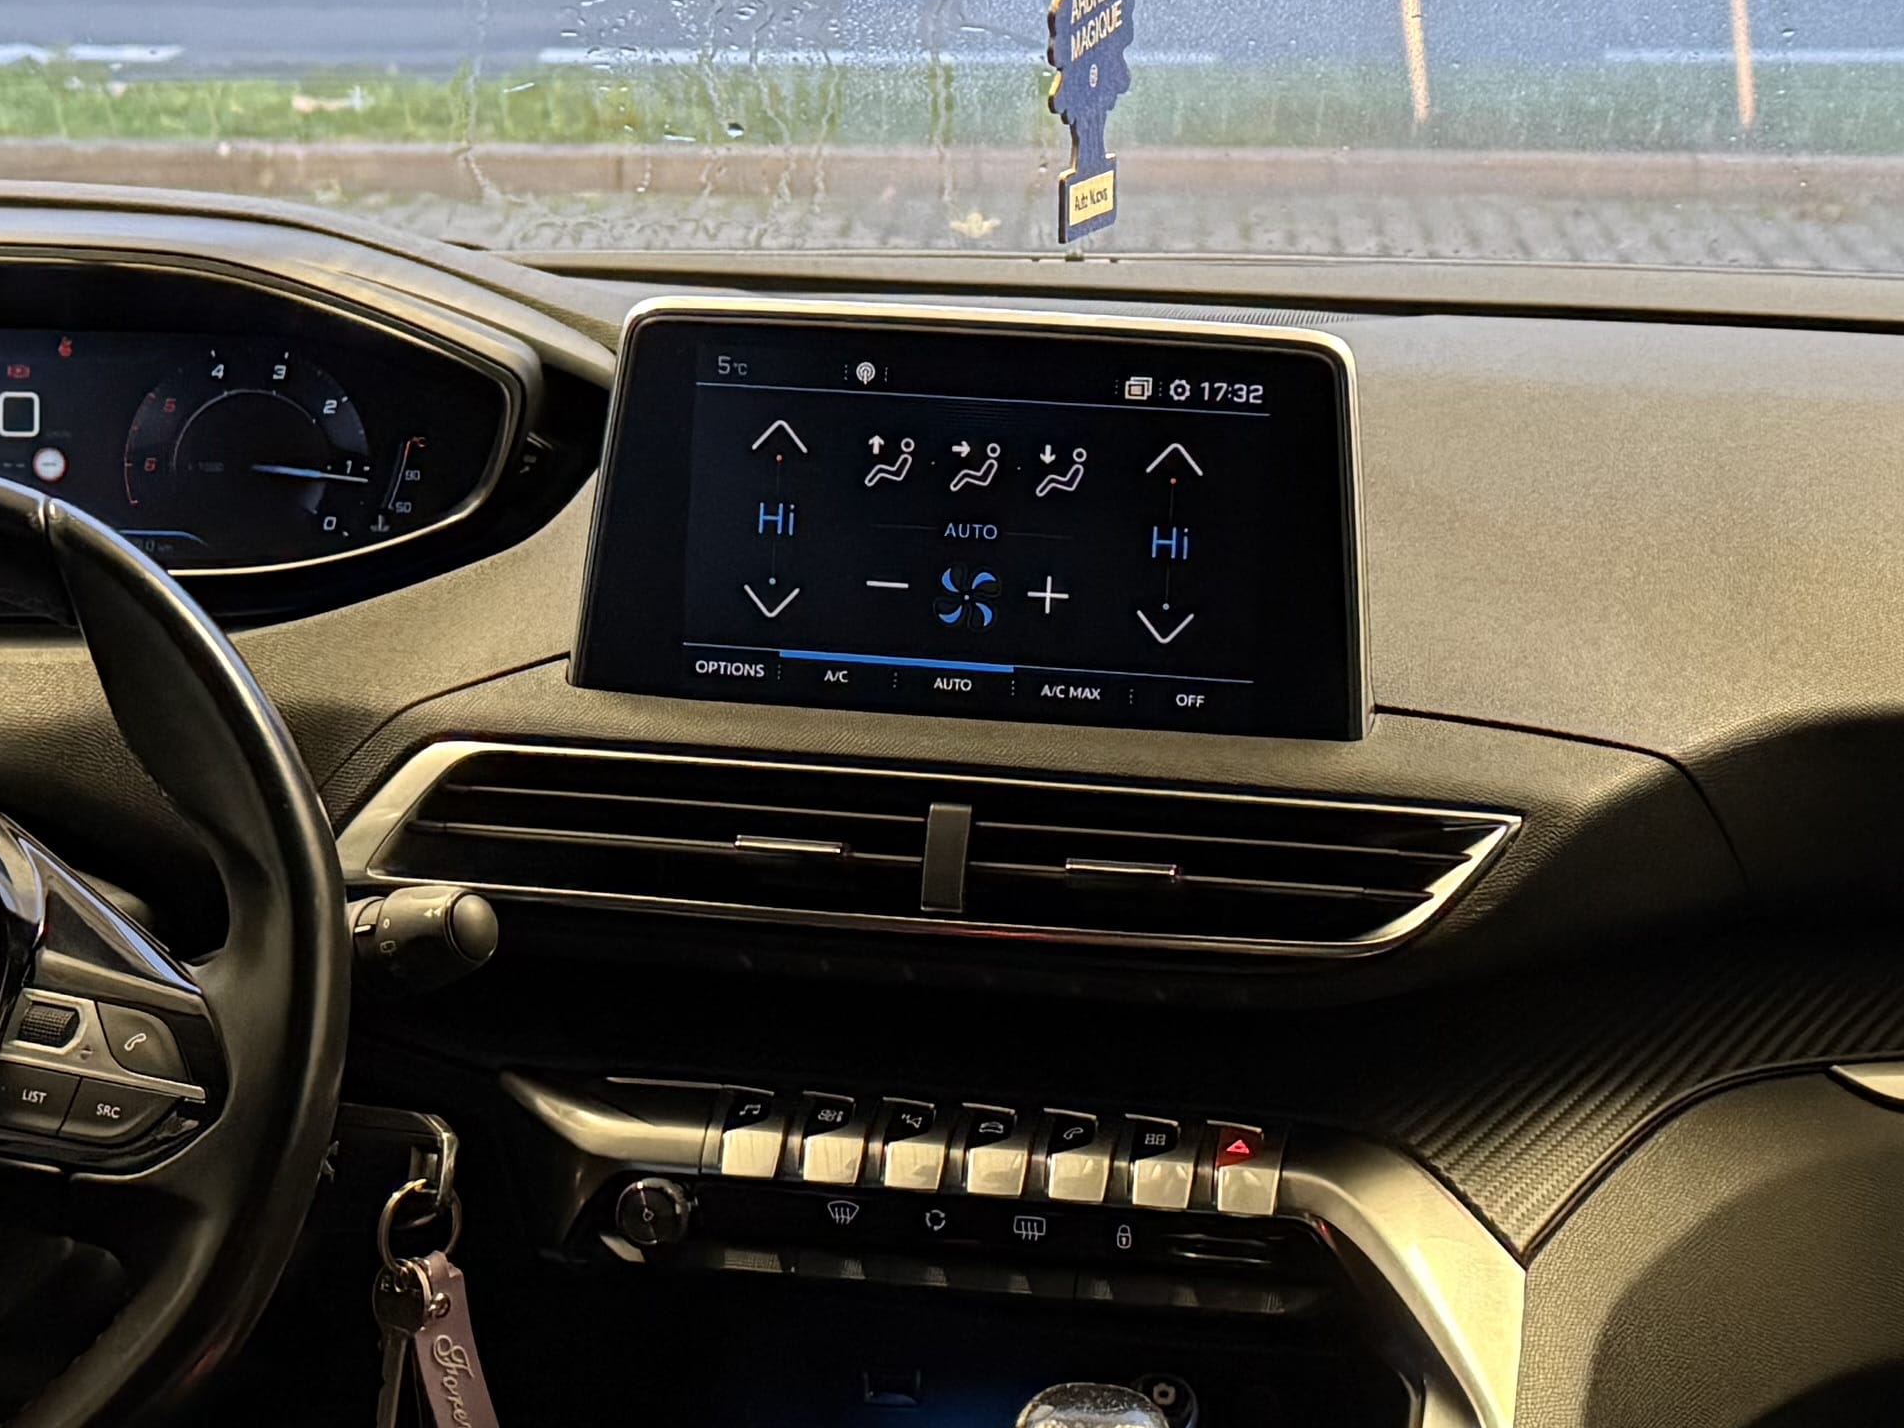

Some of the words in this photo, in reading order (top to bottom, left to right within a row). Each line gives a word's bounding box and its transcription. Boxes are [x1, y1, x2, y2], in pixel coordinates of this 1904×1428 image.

[1070, 0, 1123, 62] MAGIQUE
[210, 363, 225, 380] 4
[272, 364, 287, 380] 3
[1199, 381, 1264, 404] 17:32
[163, 398, 177, 413] 5
[322, 399, 338, 414] 2
[143, 457, 158, 472] 6
[322, 515, 338, 531] 0
[757, 501, 796, 535] Hi
[943, 522, 998, 540] AUTO
[1150, 525, 1190, 560] Hi
[695, 659, 765, 678] OPTIONS
[823, 669, 849, 683] A/C
[933, 677, 973, 692] AUTO
[1040, 684, 1065, 699] A/C
[1069, 686, 1101, 700] MAX
[1175, 693, 1205, 708] OFF
[22, 1088, 48, 1104] LIST
[96, 1102, 121, 1119] SRC
